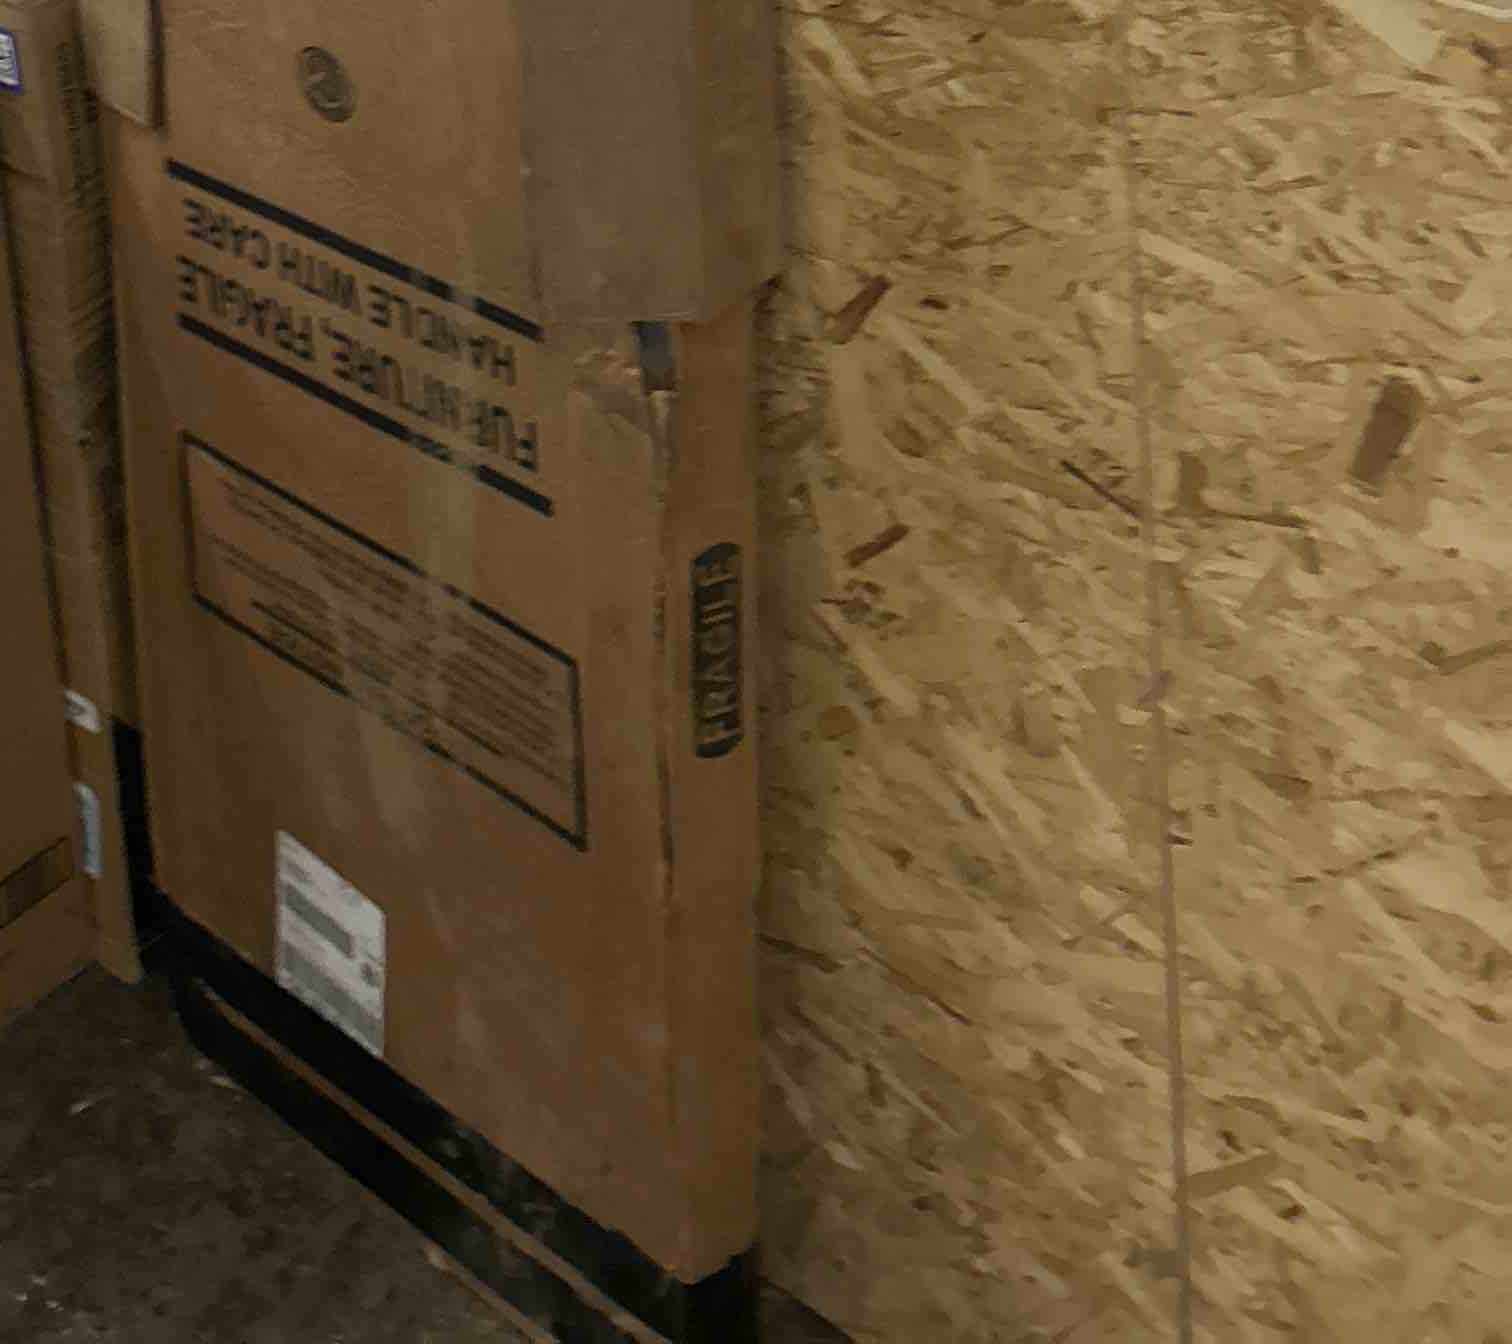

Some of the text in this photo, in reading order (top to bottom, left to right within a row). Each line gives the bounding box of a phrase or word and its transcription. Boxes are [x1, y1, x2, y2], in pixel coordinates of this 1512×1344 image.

[183, 199, 272, 270] CARE
[177, 257, 315, 363] FRAGILE
[277, 241, 362, 315] WITH
